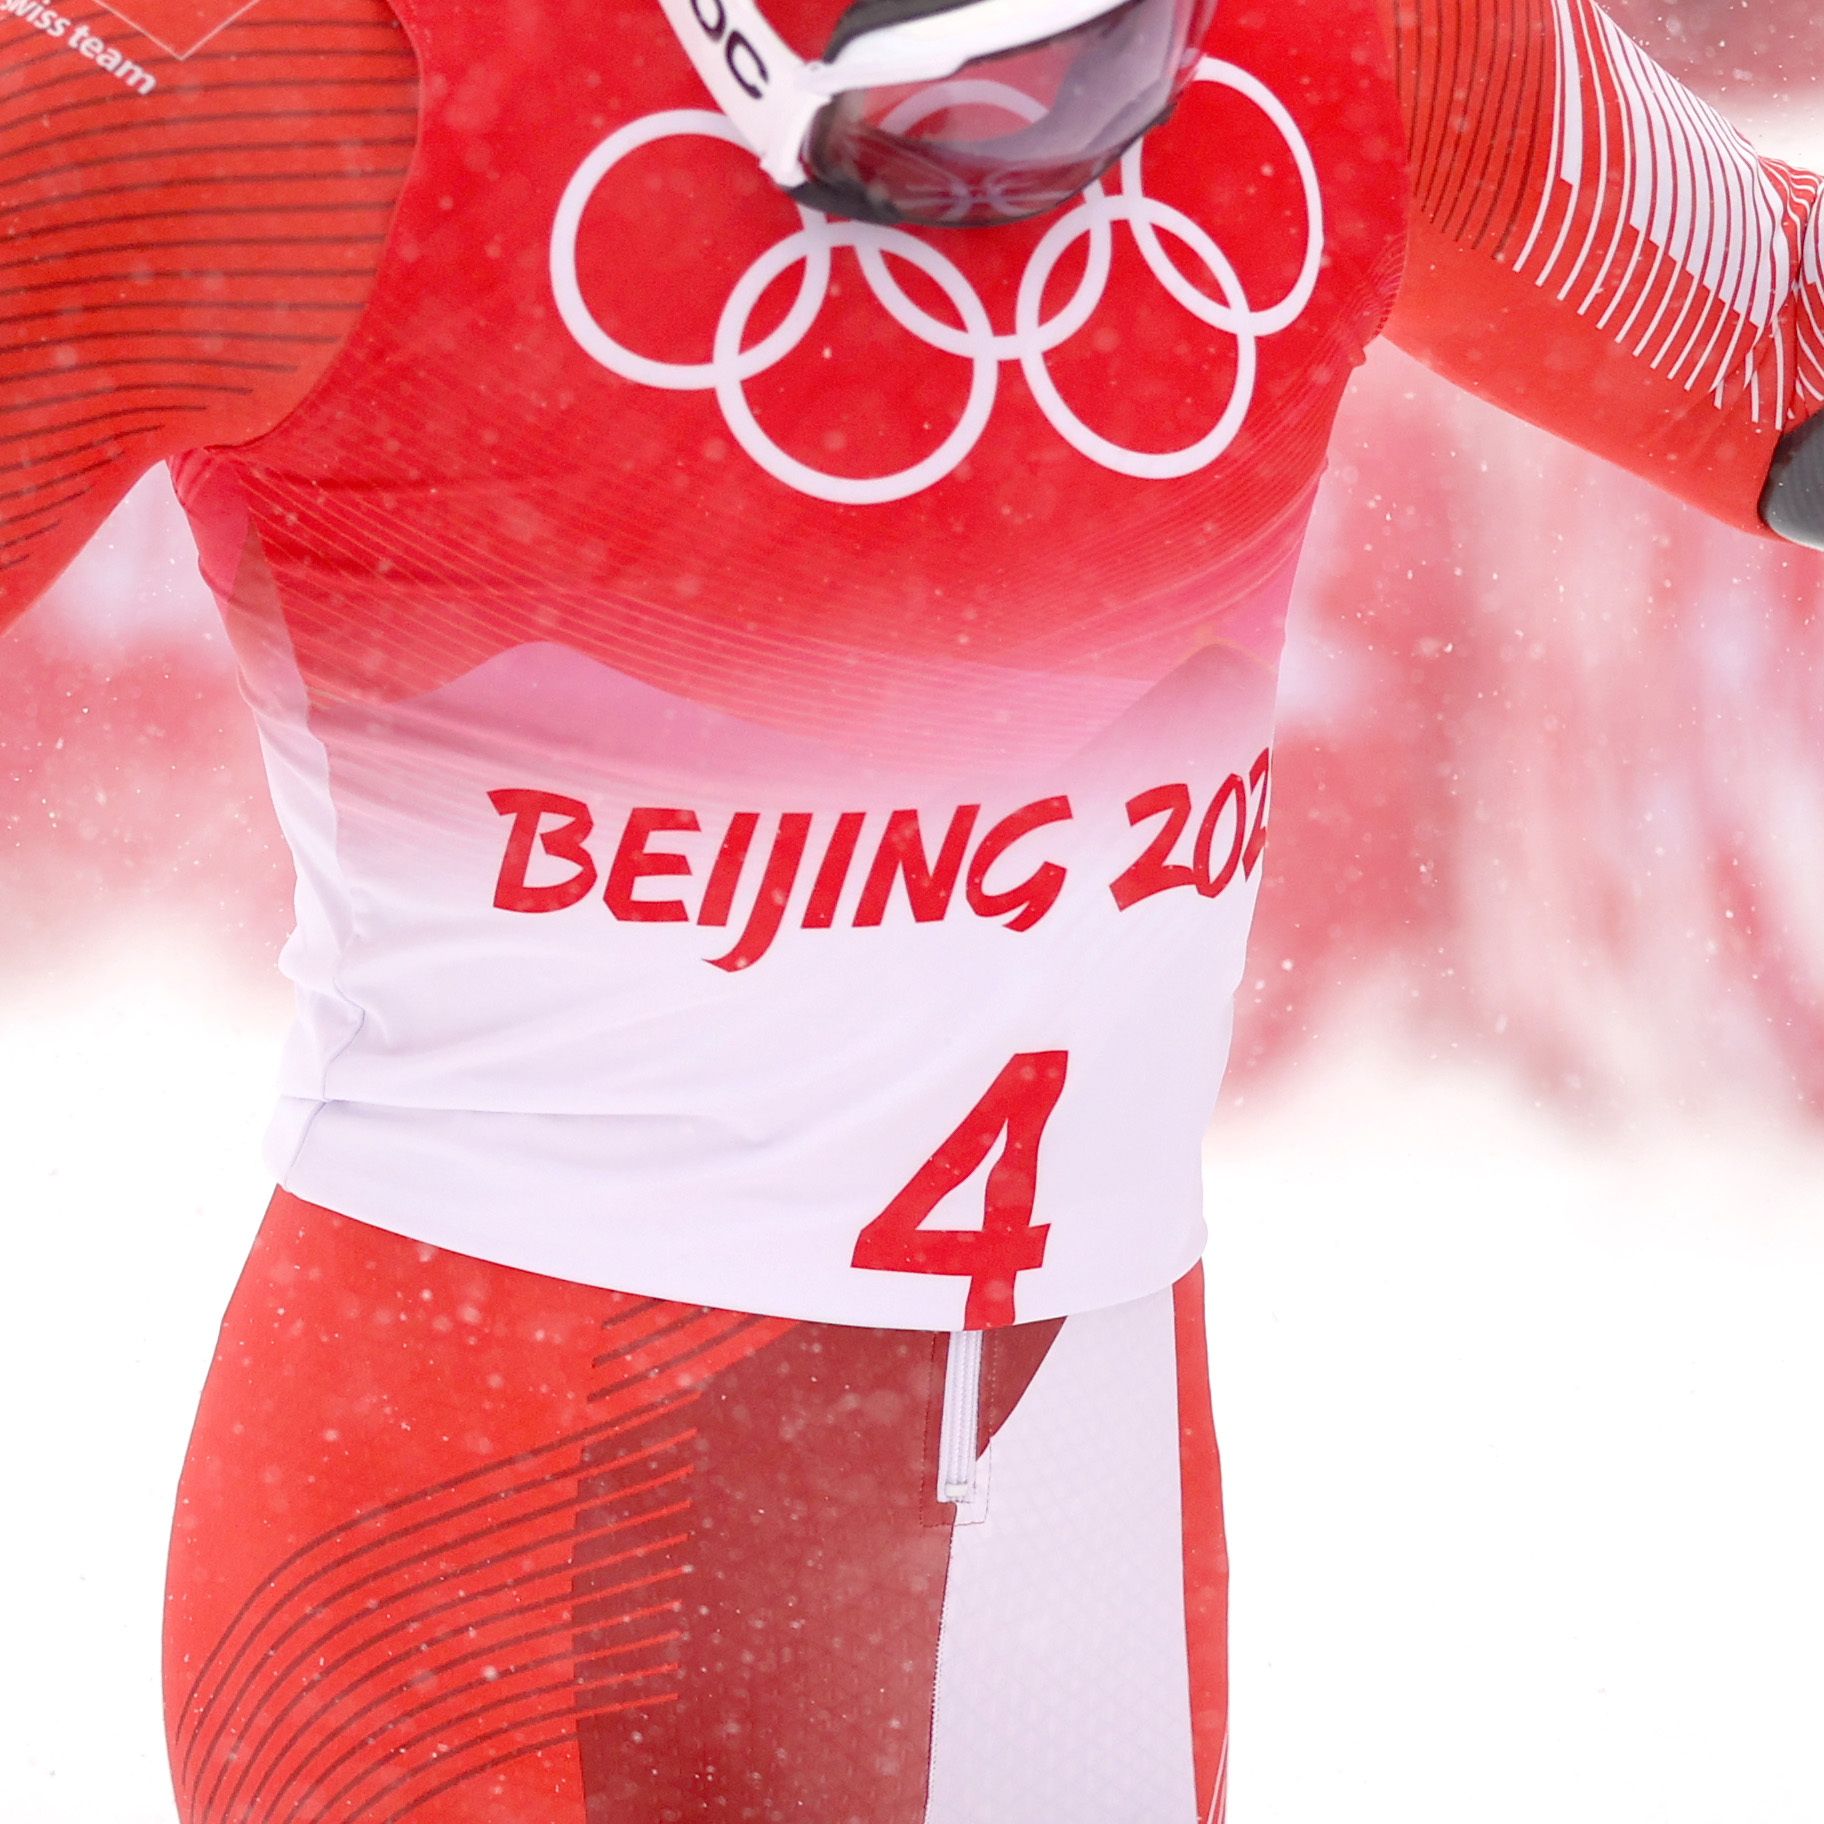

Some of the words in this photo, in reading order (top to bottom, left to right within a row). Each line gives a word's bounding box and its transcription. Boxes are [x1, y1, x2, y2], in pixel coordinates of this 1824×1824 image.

[67, 24, 157, 95] team
[486, 787, 1073, 973] BEIJING
[850, 1049, 1069, 1331] 4
